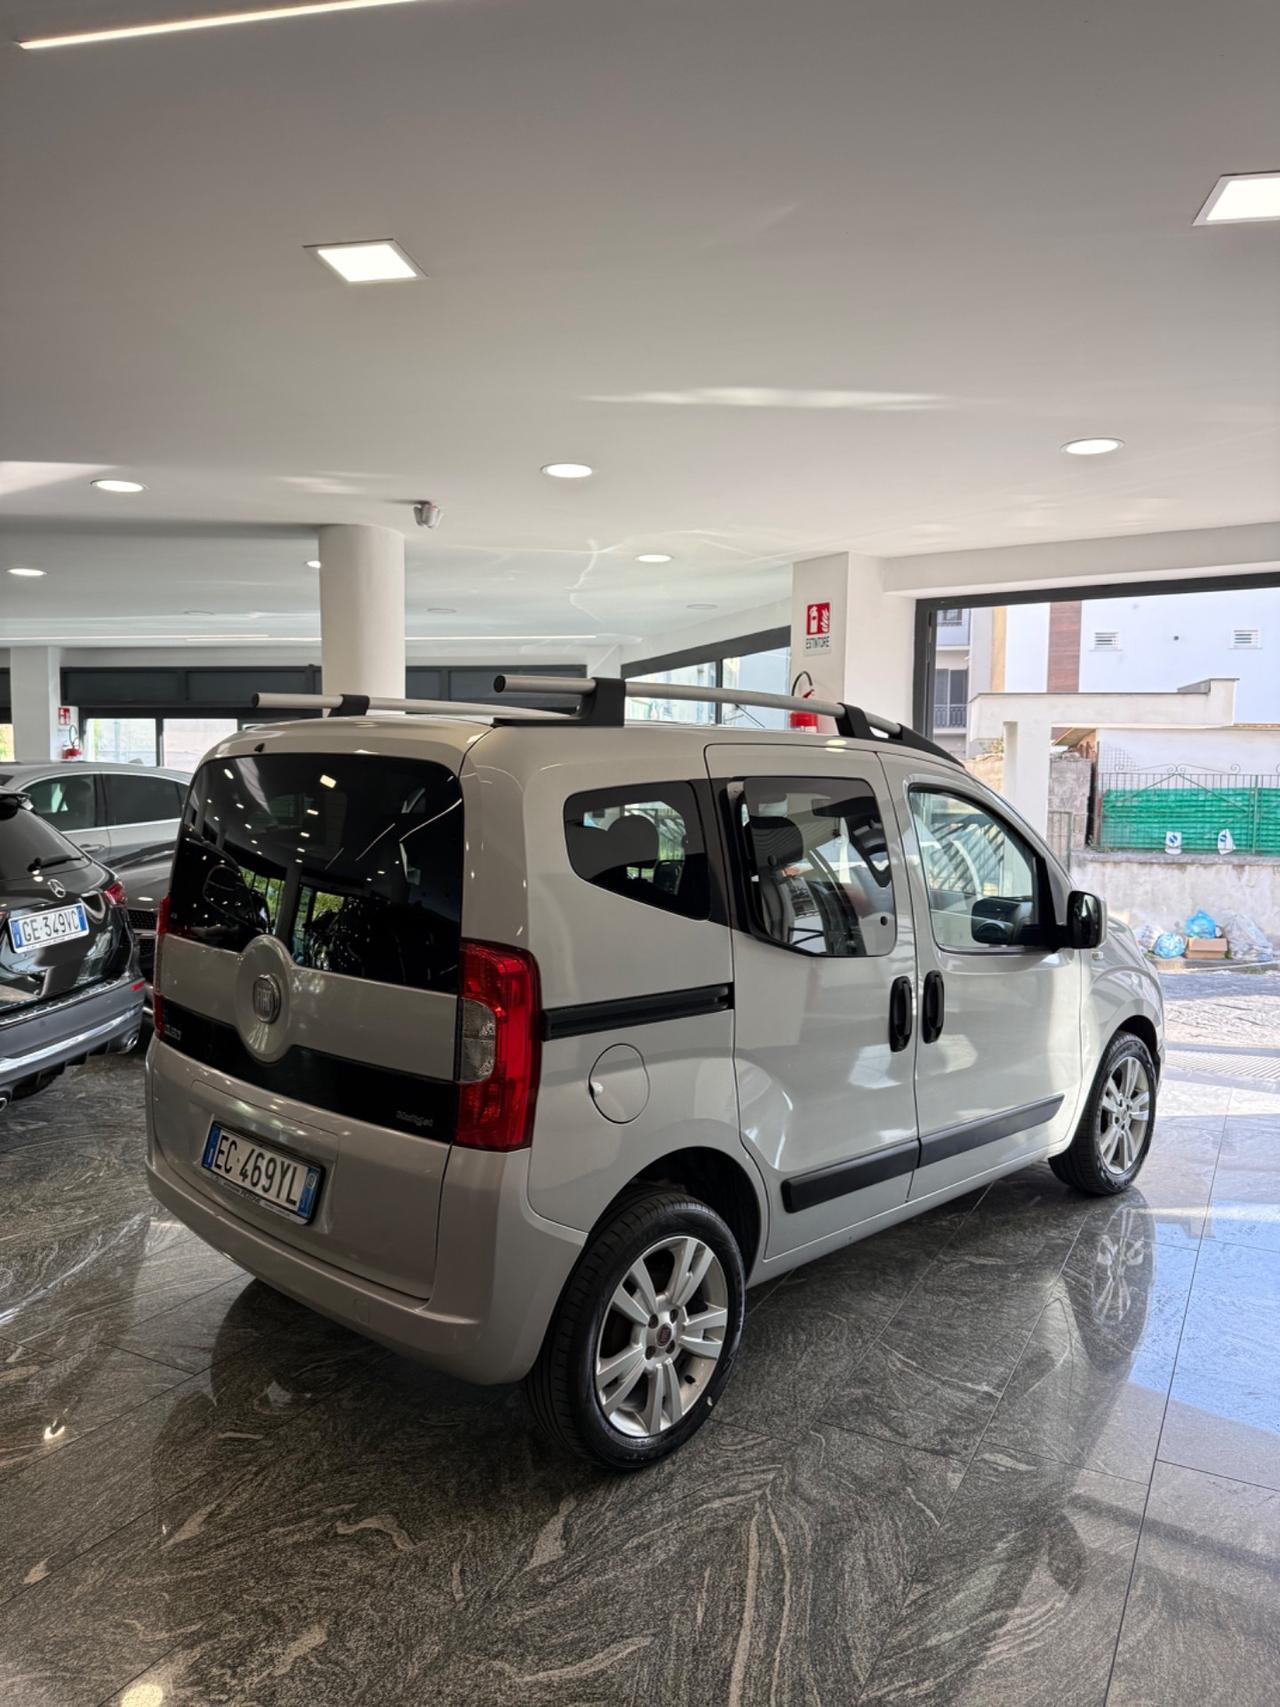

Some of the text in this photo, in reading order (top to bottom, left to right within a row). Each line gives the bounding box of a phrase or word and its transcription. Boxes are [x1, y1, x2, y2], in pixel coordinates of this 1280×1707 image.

[22, 919, 41, 943] GE
[214, 1135, 238, 1174] EC
[239, 1148, 299, 1207] 469YL
